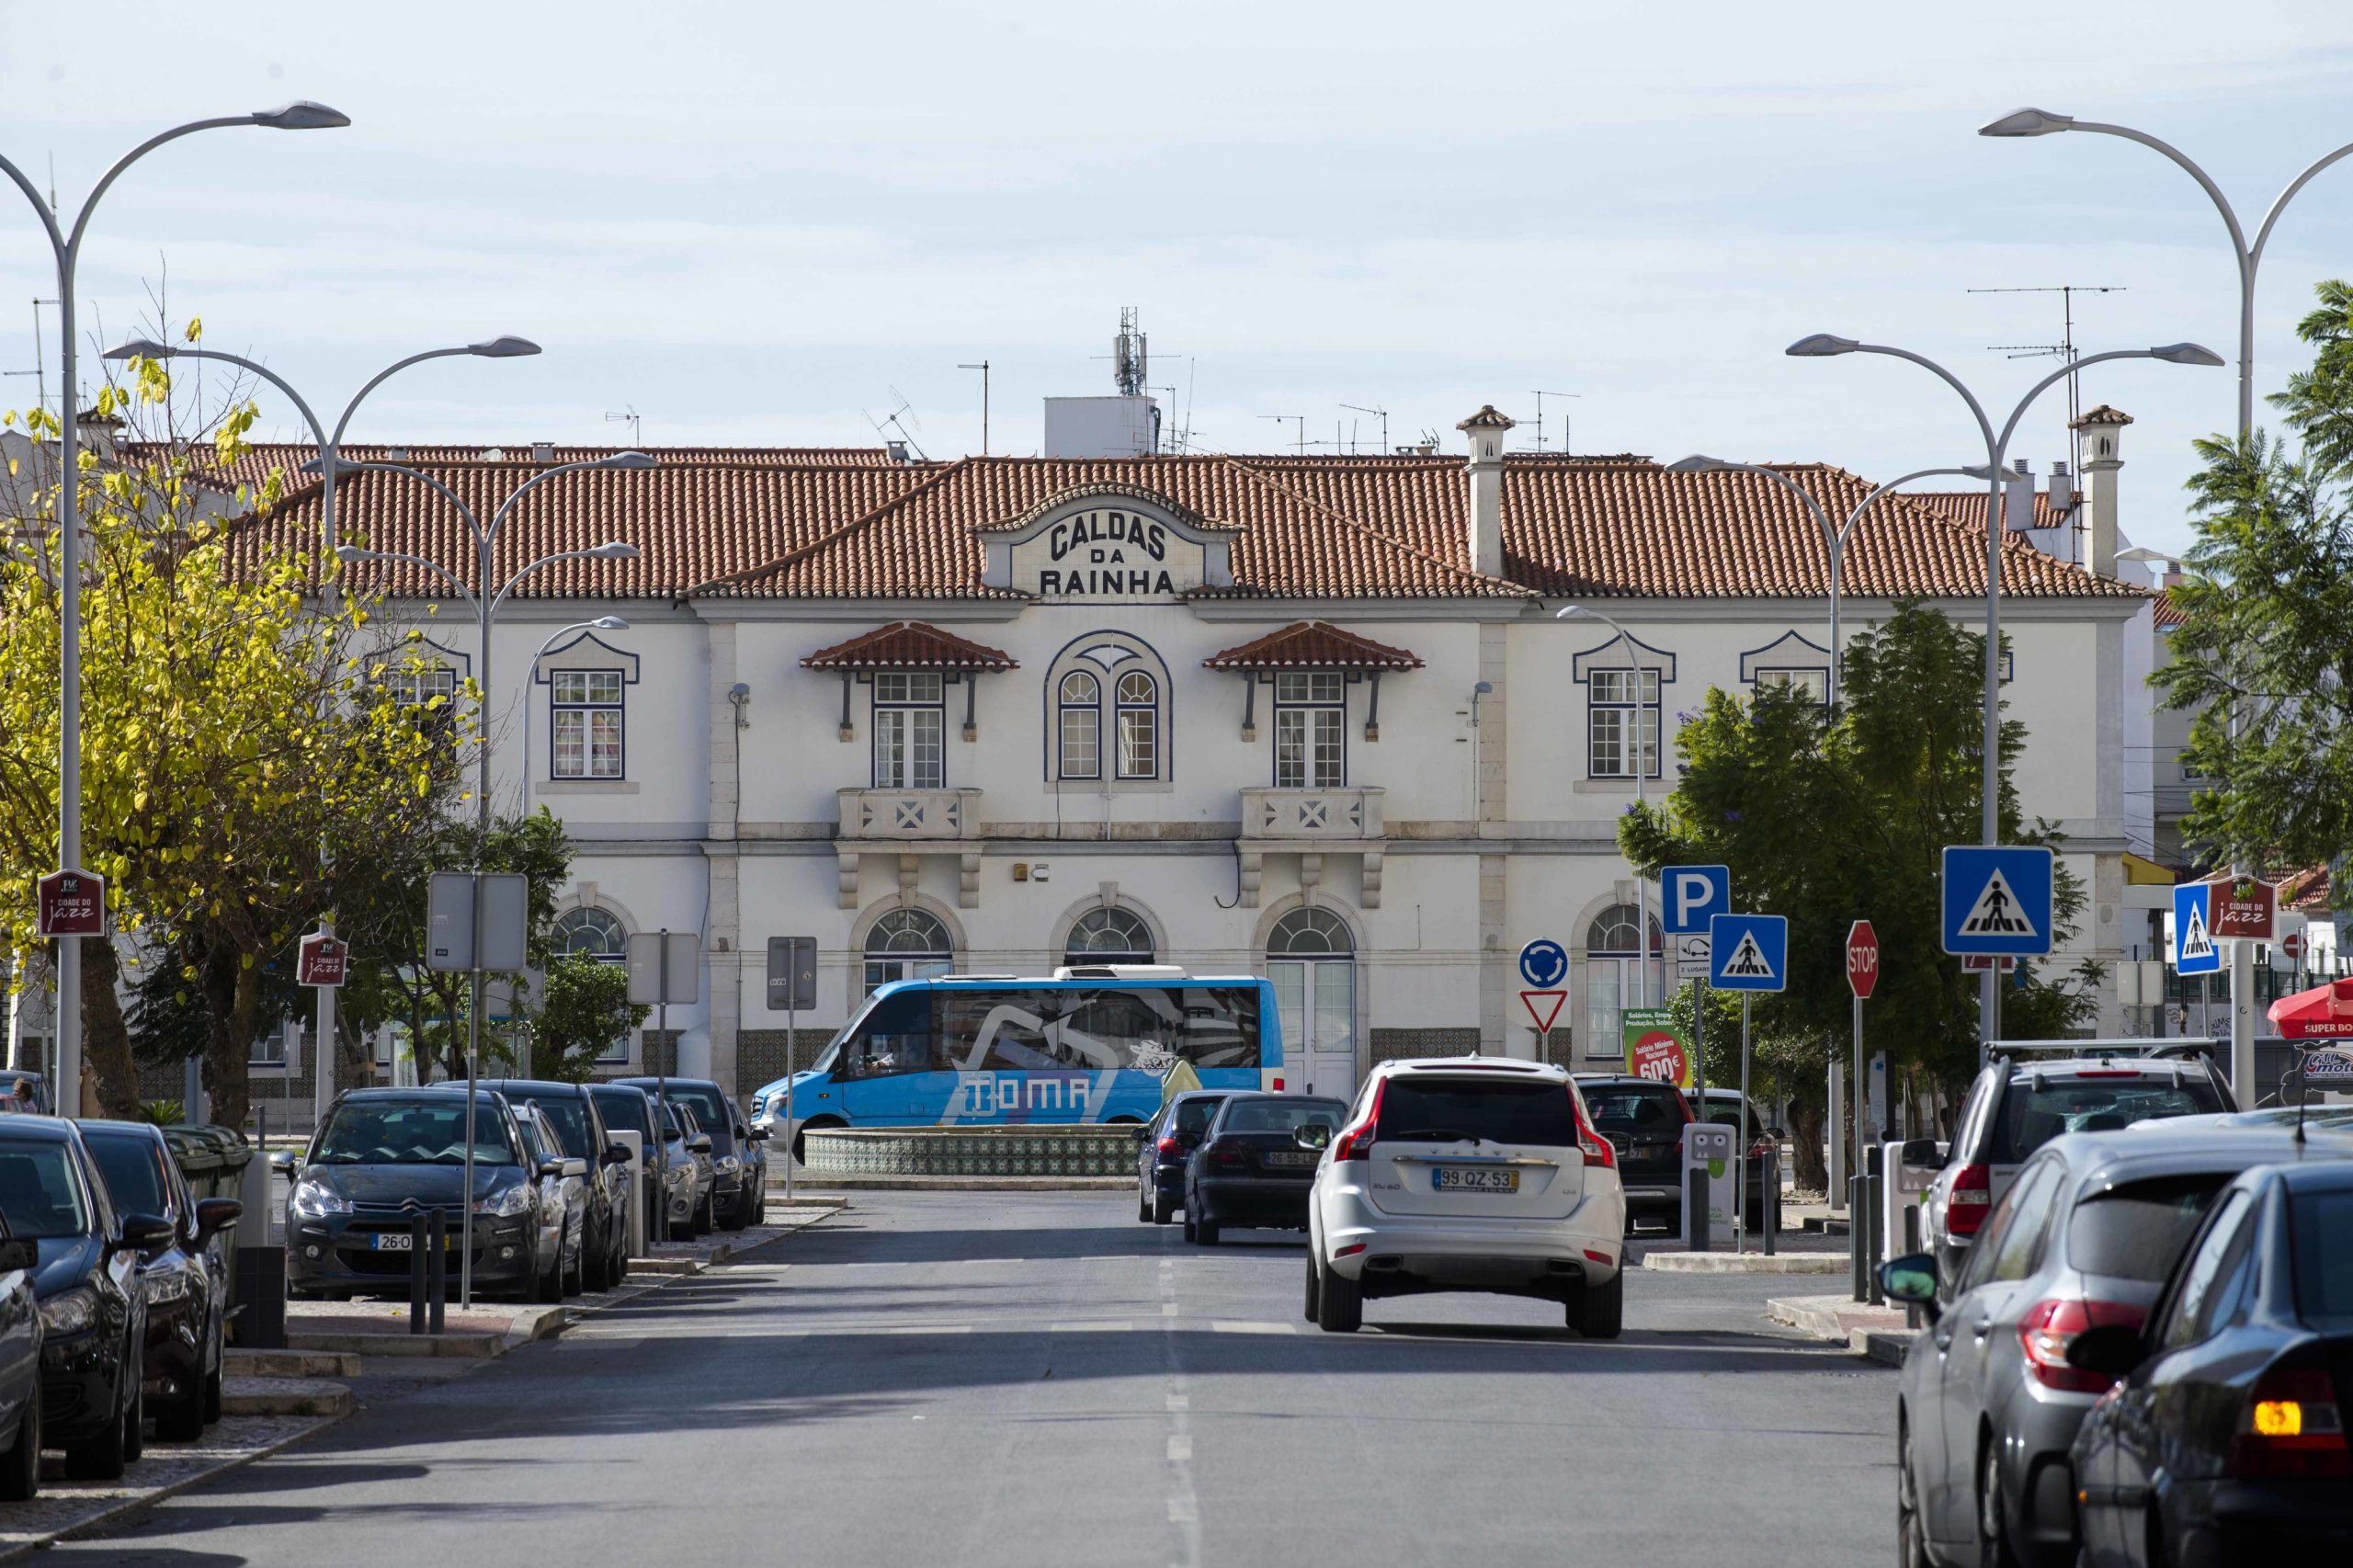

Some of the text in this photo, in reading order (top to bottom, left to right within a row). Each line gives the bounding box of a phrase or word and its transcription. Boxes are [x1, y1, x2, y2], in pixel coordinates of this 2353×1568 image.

[1051, 512, 1165, 562] CALDAS
[1090, 549, 1125, 563] DA
[1040, 570, 1176, 594] RAINHA
[58, 898, 91, 906] CIDADE DO
[1677, 873, 1713, 926] P
[2229, 903, 2253, 911] CIDADE
[47, 899, 95, 932] jazz
[2216, 902, 2267, 935] jazz
[306, 957, 340, 983] jazz
[1849, 946, 1877, 972] STOP
[2304, 1023, 2353, 1033] SUPER BO
[1645, 1048, 1668, 1060] Nacional
[965, 1078, 1090, 1109] TOMA
